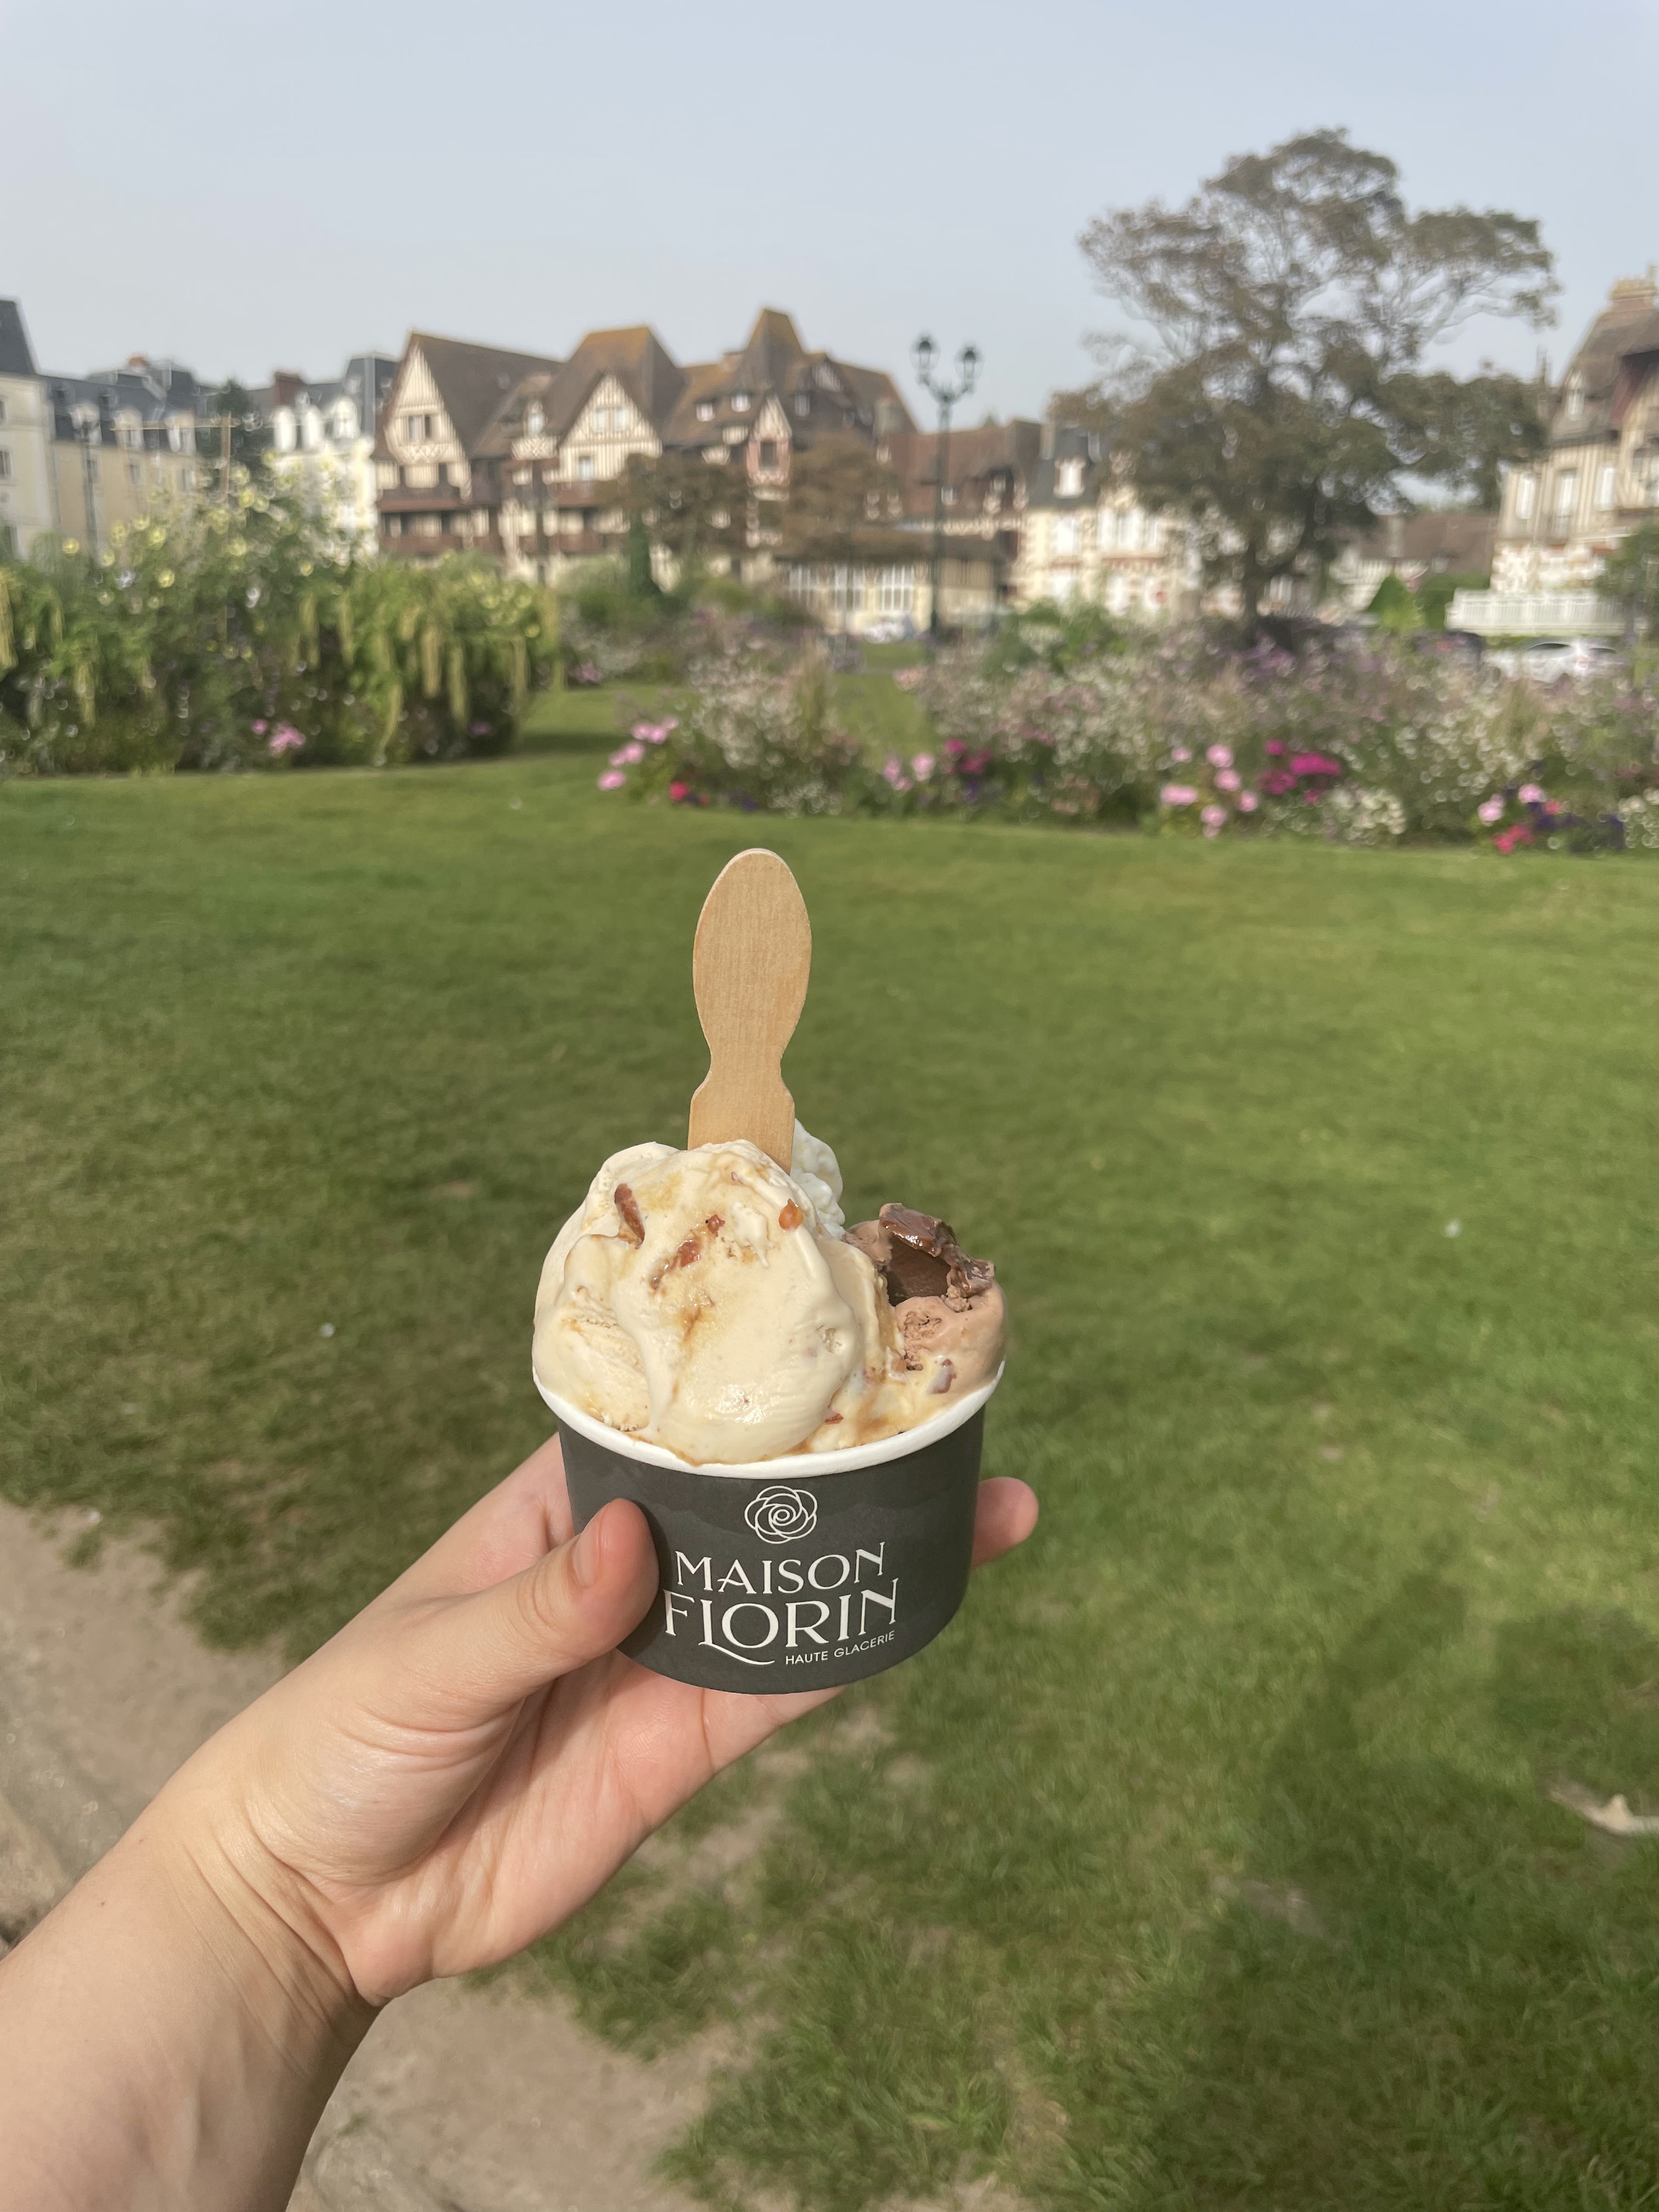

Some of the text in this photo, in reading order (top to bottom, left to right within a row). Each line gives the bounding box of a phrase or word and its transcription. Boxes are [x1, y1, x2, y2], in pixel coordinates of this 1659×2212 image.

[675, 1541, 885, 1595] MAISON
[663, 1577, 899, 1666] FLORIN
[785, 1630, 895, 1666] HAUTE GLACERIE
